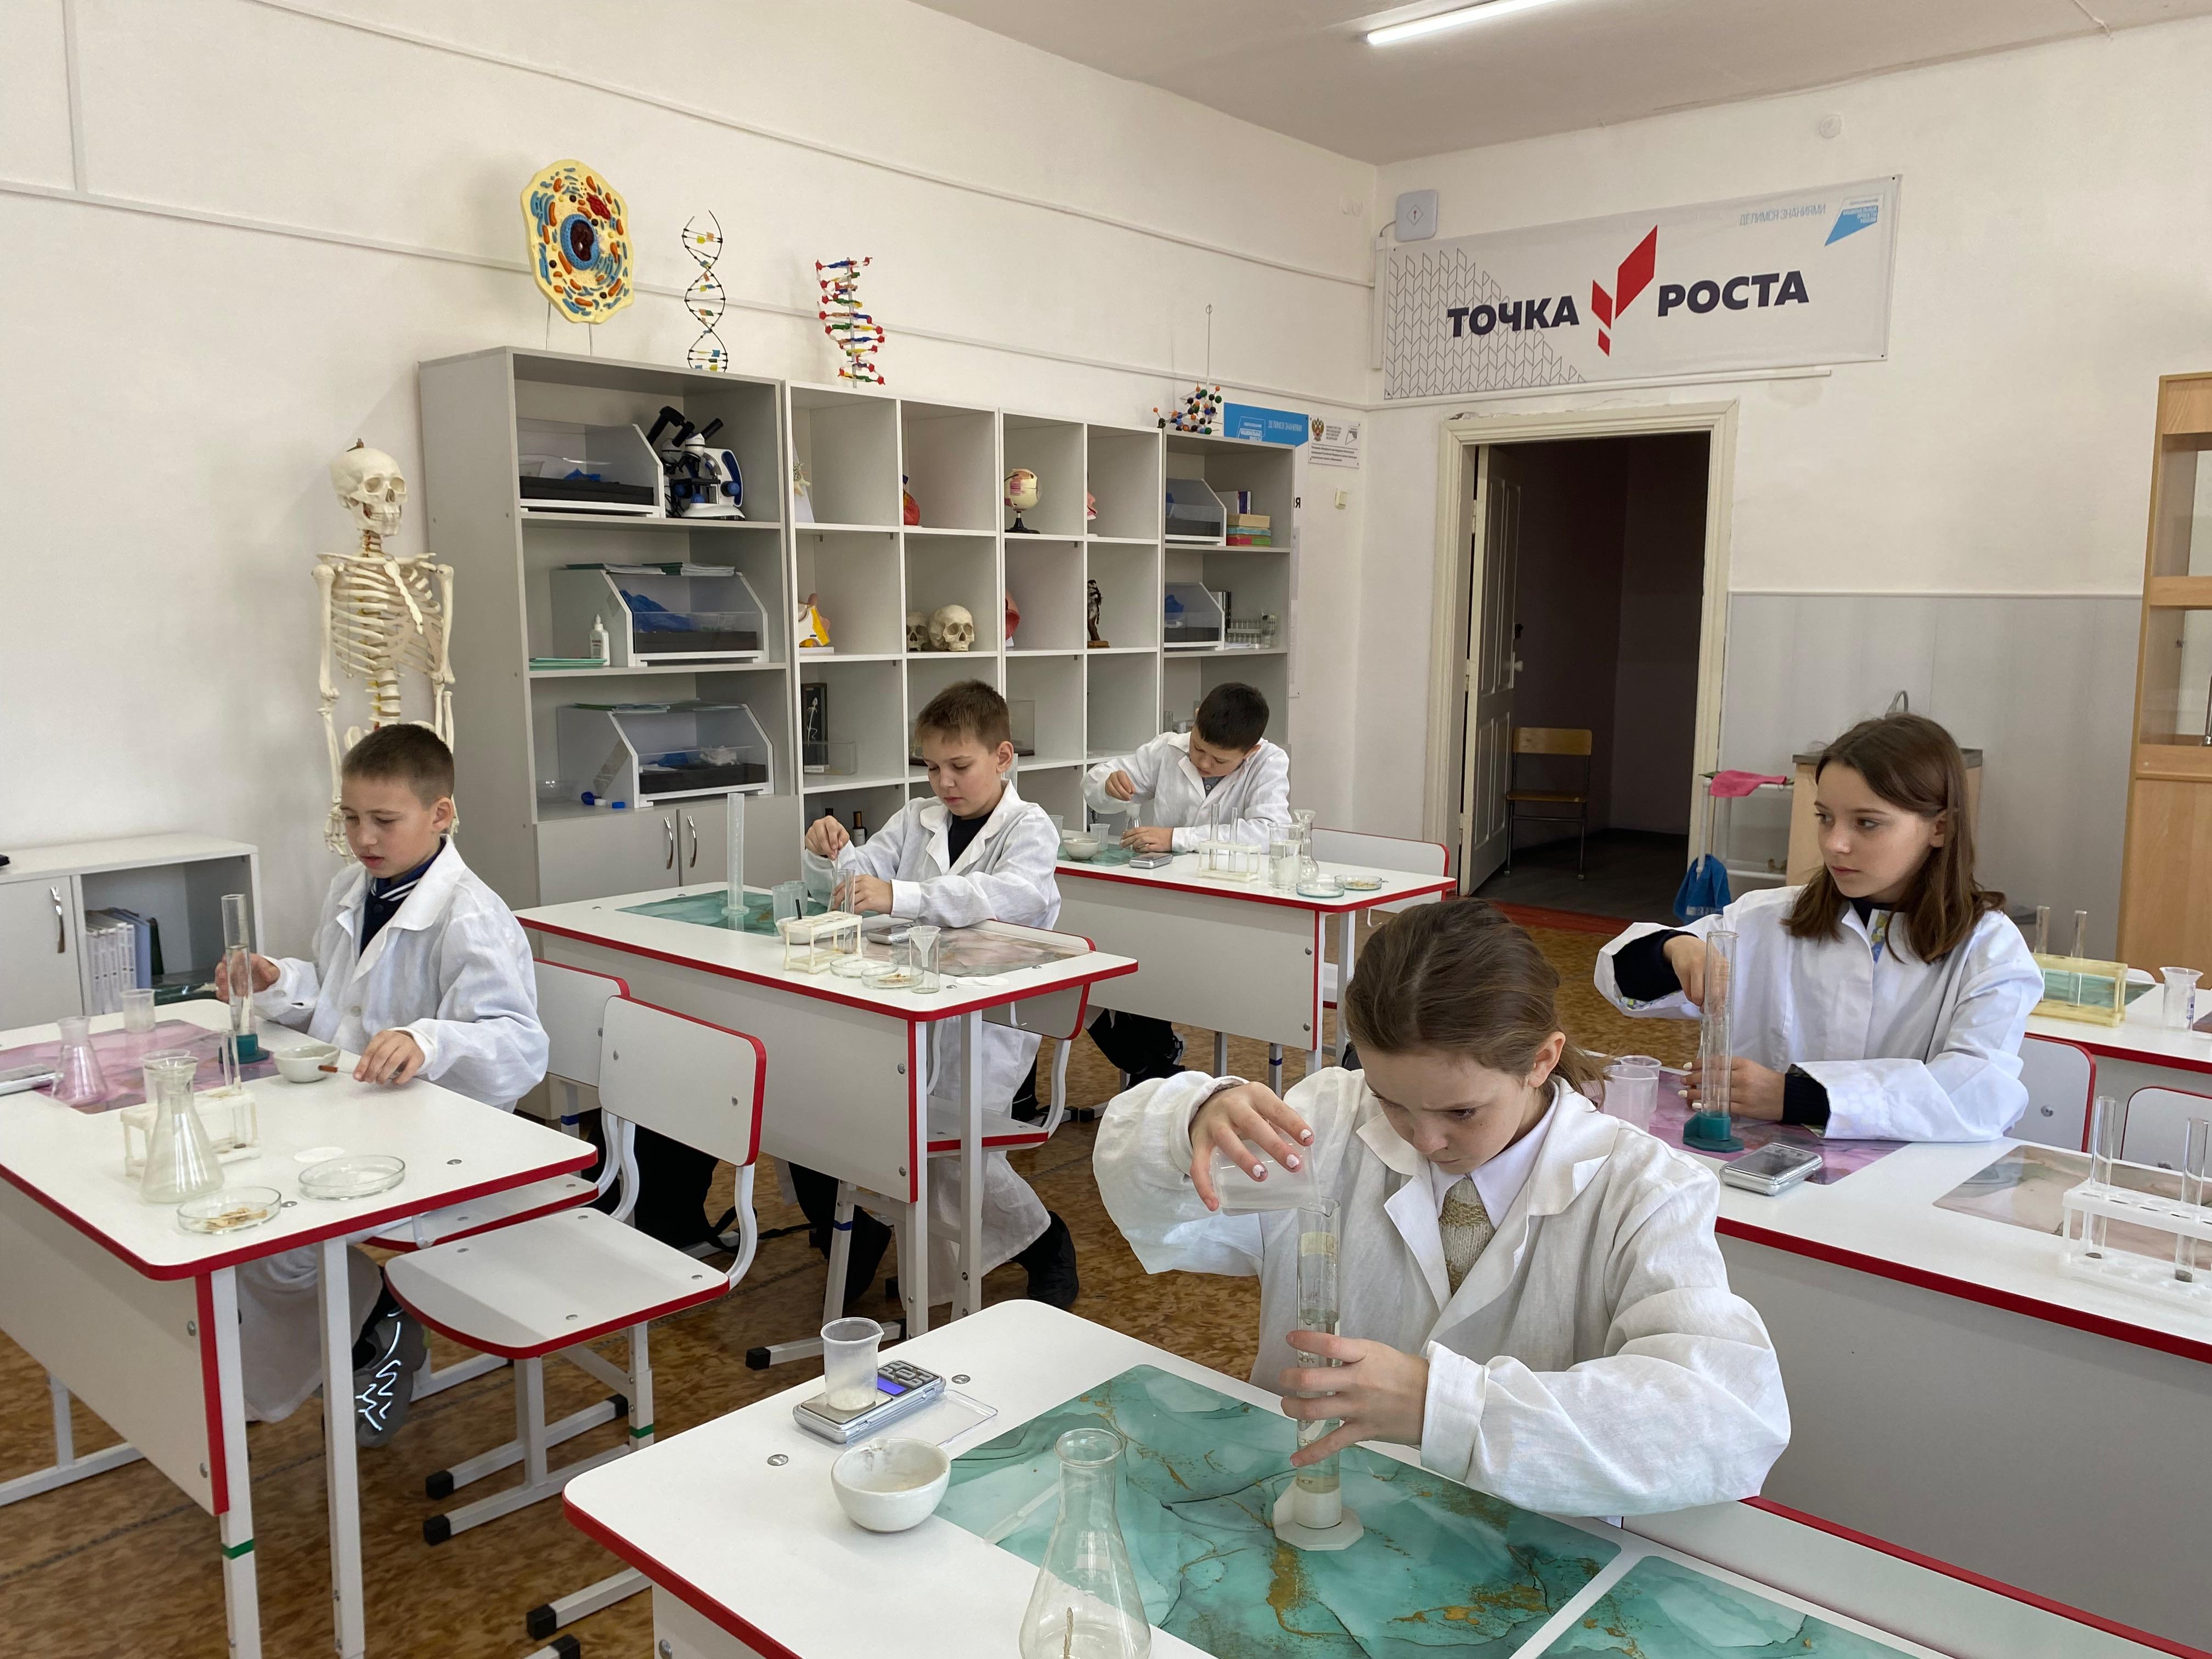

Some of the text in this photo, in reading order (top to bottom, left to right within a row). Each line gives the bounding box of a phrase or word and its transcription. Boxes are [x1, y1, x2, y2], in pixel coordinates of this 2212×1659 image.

[1739, 209, 1779, 226] ДЕЛИМСЯ
[1780, 203, 1826, 220] ЗНАНИЯМИ
[1448, 271, 1809, 337] ТОЧКА РОСТА
